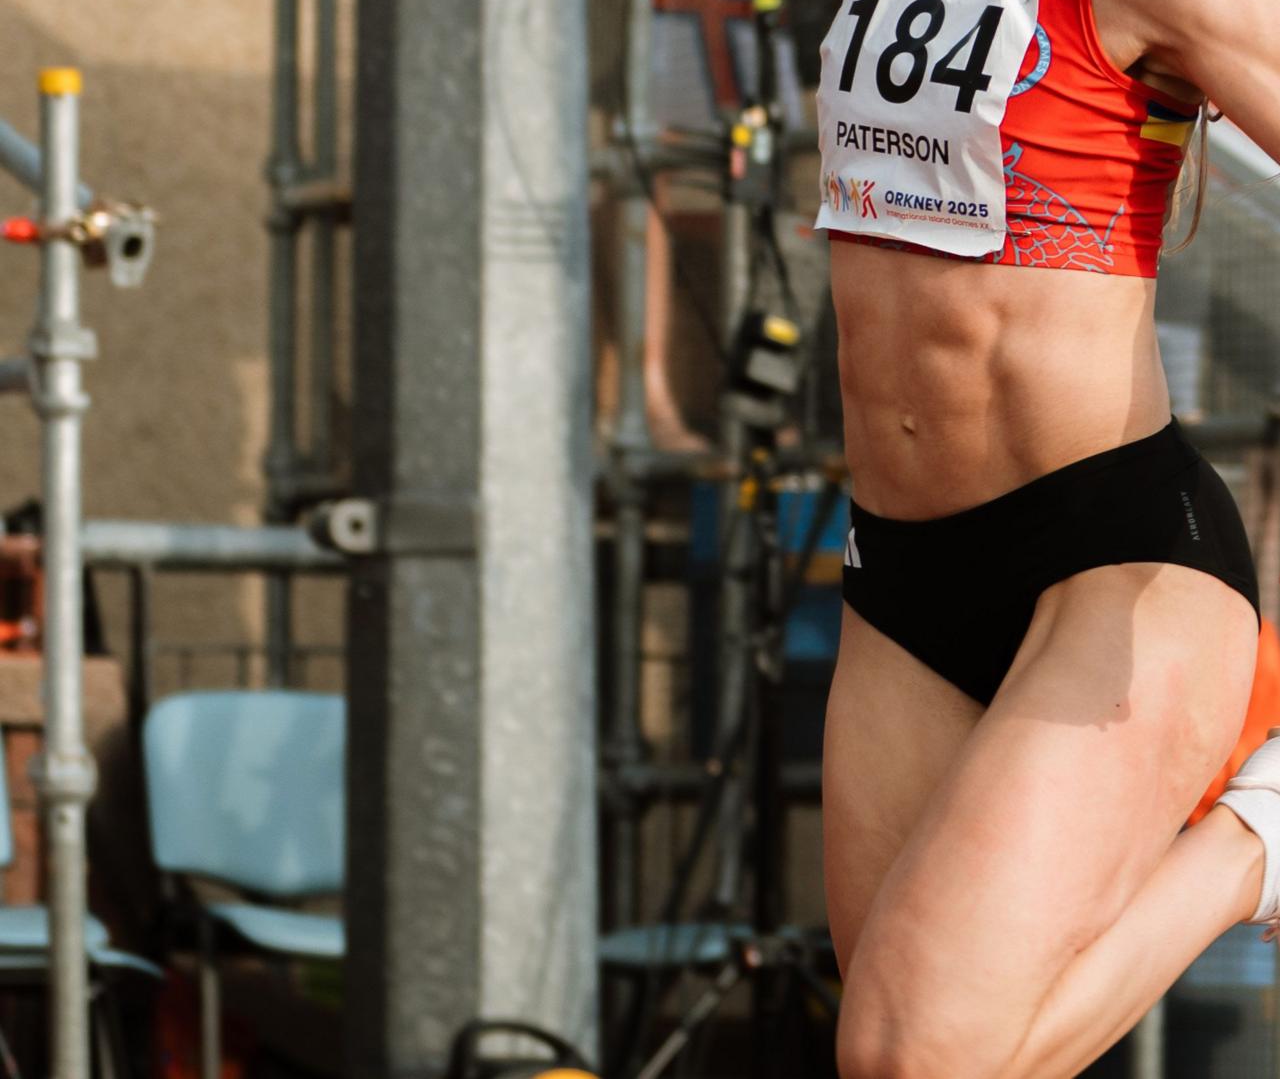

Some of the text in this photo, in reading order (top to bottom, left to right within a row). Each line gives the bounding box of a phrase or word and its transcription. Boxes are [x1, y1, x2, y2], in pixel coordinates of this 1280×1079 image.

[837, 121, 949, 165] PATERSON
[885, 191, 988, 217] ORKNEY 2025
[886, 210, 928, 221] International
[928, 215, 951, 224] Island
[952, 218, 979, 229] Games
